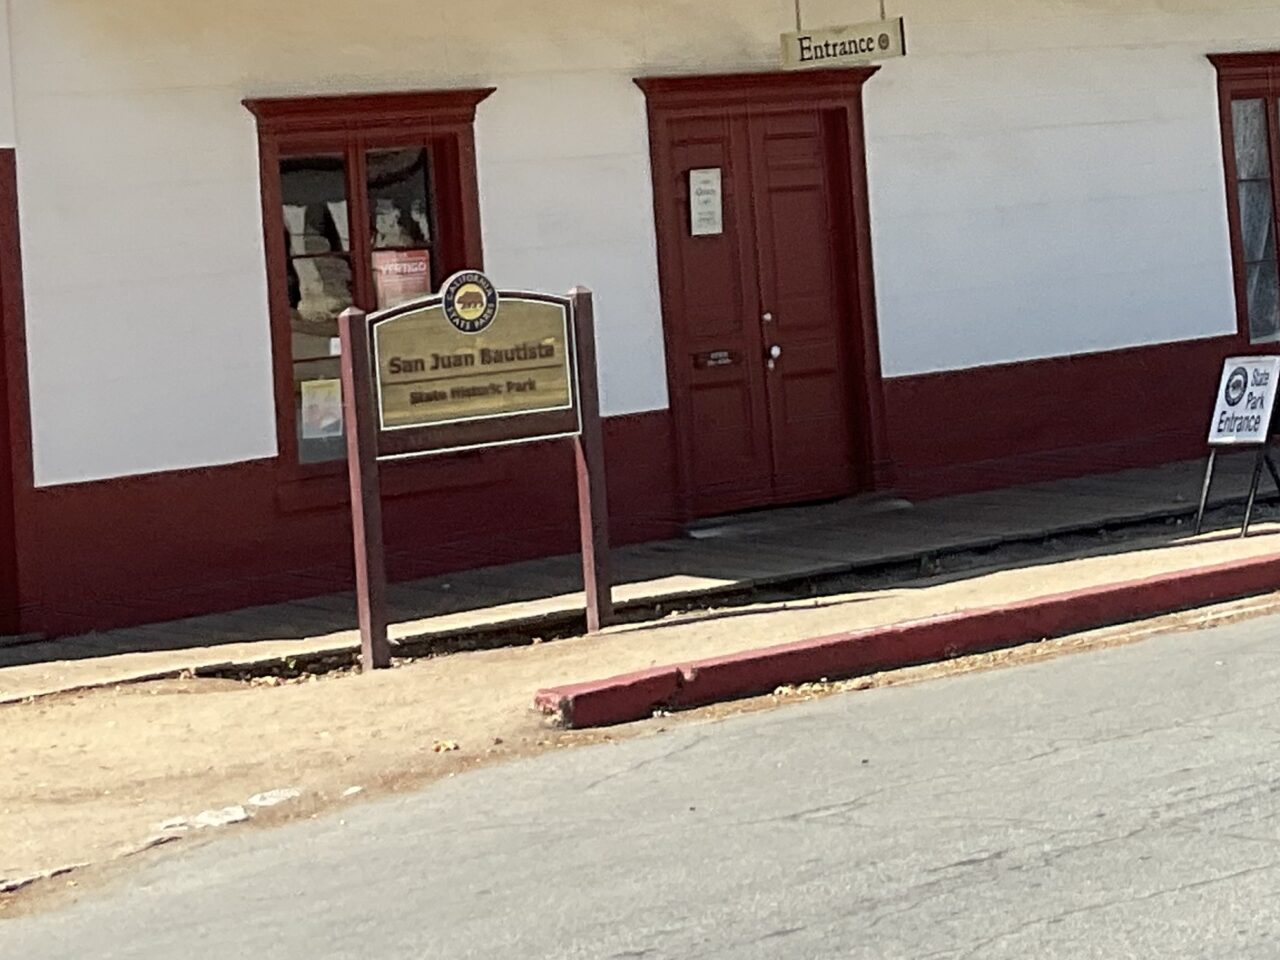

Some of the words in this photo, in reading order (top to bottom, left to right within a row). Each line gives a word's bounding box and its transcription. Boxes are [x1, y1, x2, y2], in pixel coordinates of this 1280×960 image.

[797, 36, 875, 61] Entrance
[446, 273, 493, 300] CALIFORNIA
[446, 306, 471, 330] STATE
[473, 303, 495, 329] PARKS
[388, 356, 425, 375] San
[430, 350, 475, 370] Juan
[480, 342, 555, 365] Bautista
[1250, 368, 1270, 387] State
[409, 390, 447, 405] State
[506, 377, 536, 393] Park
[1245, 392, 1265, 410] Park
[1217, 411, 1261, 433] Entrance
